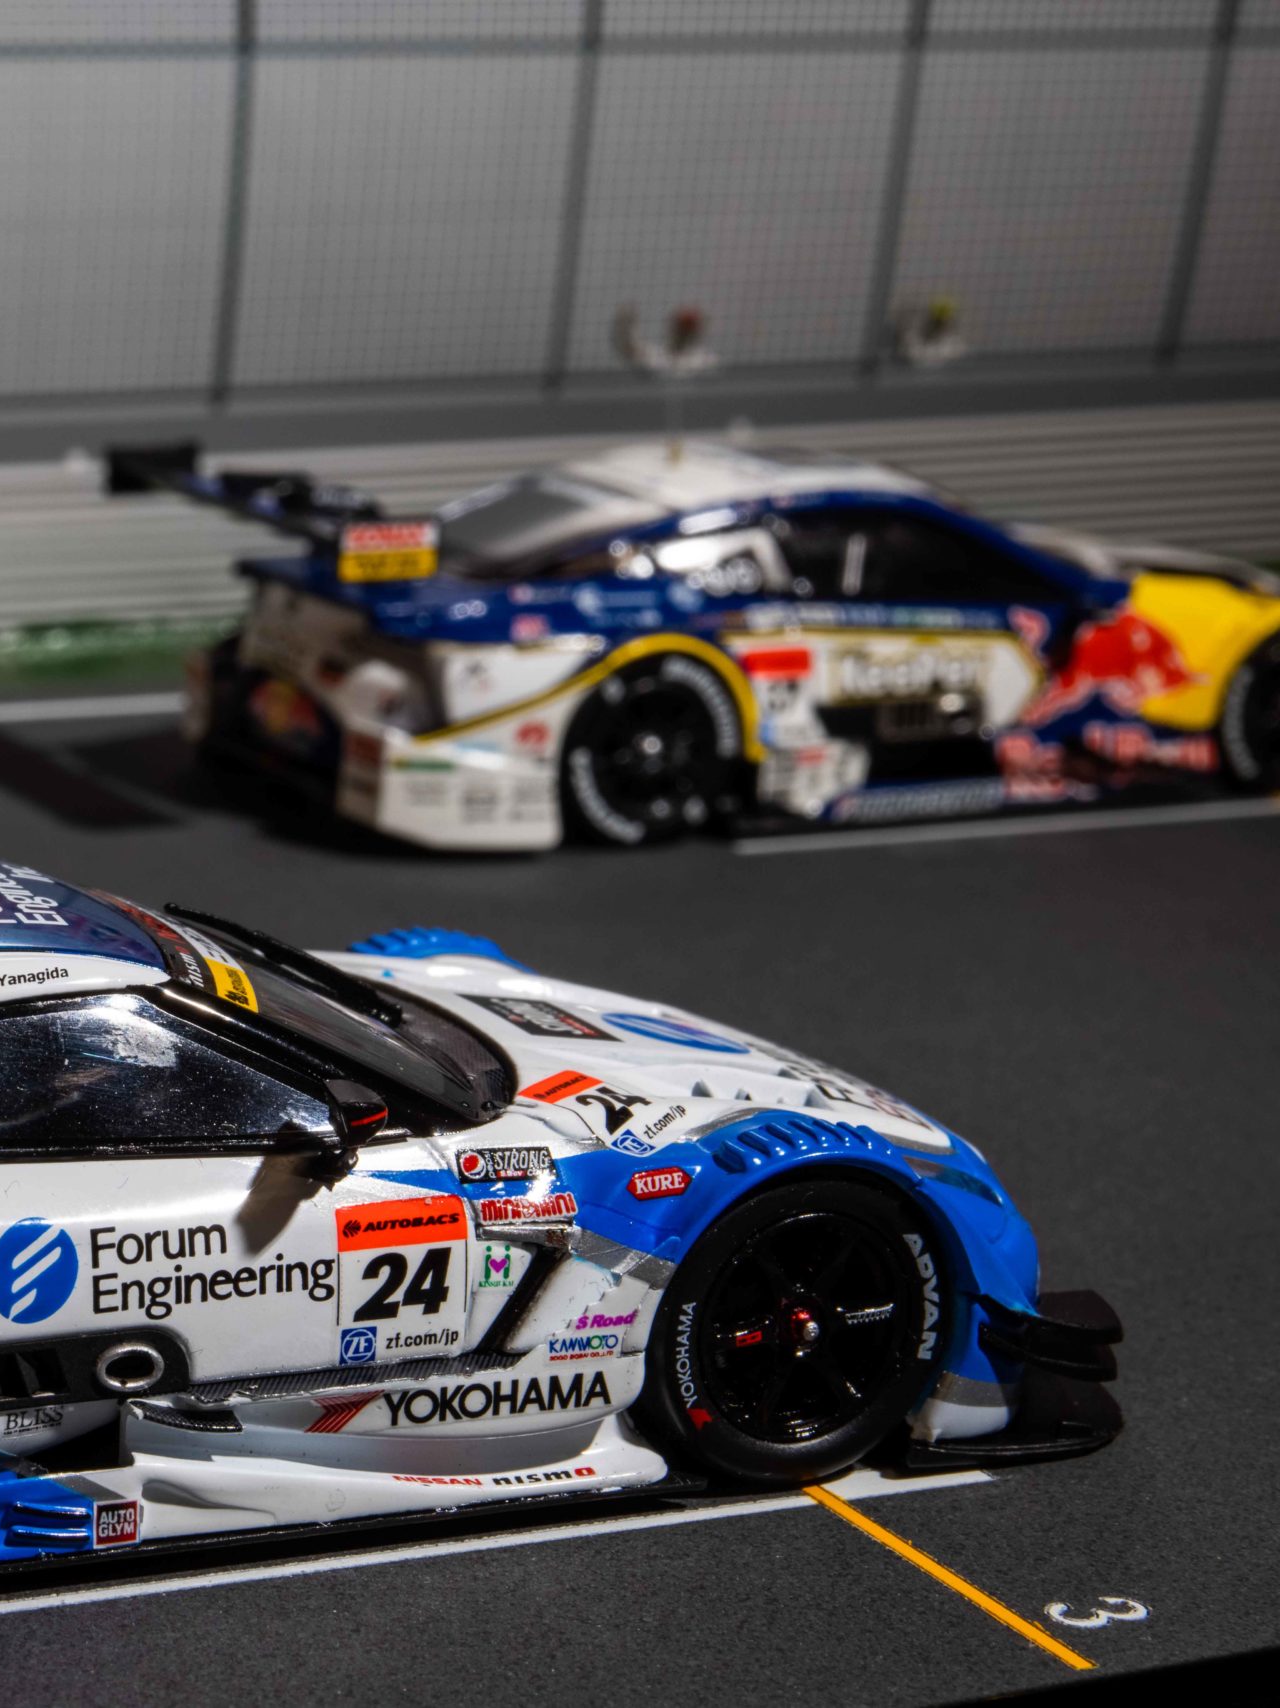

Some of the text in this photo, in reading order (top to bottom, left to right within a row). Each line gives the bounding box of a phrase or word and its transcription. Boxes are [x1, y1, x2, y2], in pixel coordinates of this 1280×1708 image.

[575, 1086, 652, 1135] 24
[495, 1150, 549, 1170] STRONG
[635, 1171, 685, 1194] KURE
[363, 1213, 460, 1232] AUTOBACS
[90, 1224, 227, 1268] Forum
[92, 1253, 335, 1320] Engineering
[353, 1247, 452, 1322] 24
[902, 1233, 939, 1360] ADVAN
[576, 1308, 638, 1330] S Road
[346, 1335, 370, 1358] ZF
[386, 1328, 459, 1349] zf.com/jp
[676, 1302, 697, 1408] YOKOHAMA
[383, 1370, 612, 1426] YOKOHAMA
[4, 1408, 65, 1431] BLISS
[392, 1467, 596, 1486] NISSAN nismo
[98, 1507, 134, 1525] AUTO
[98, 1520, 135, 1538] GLYM
